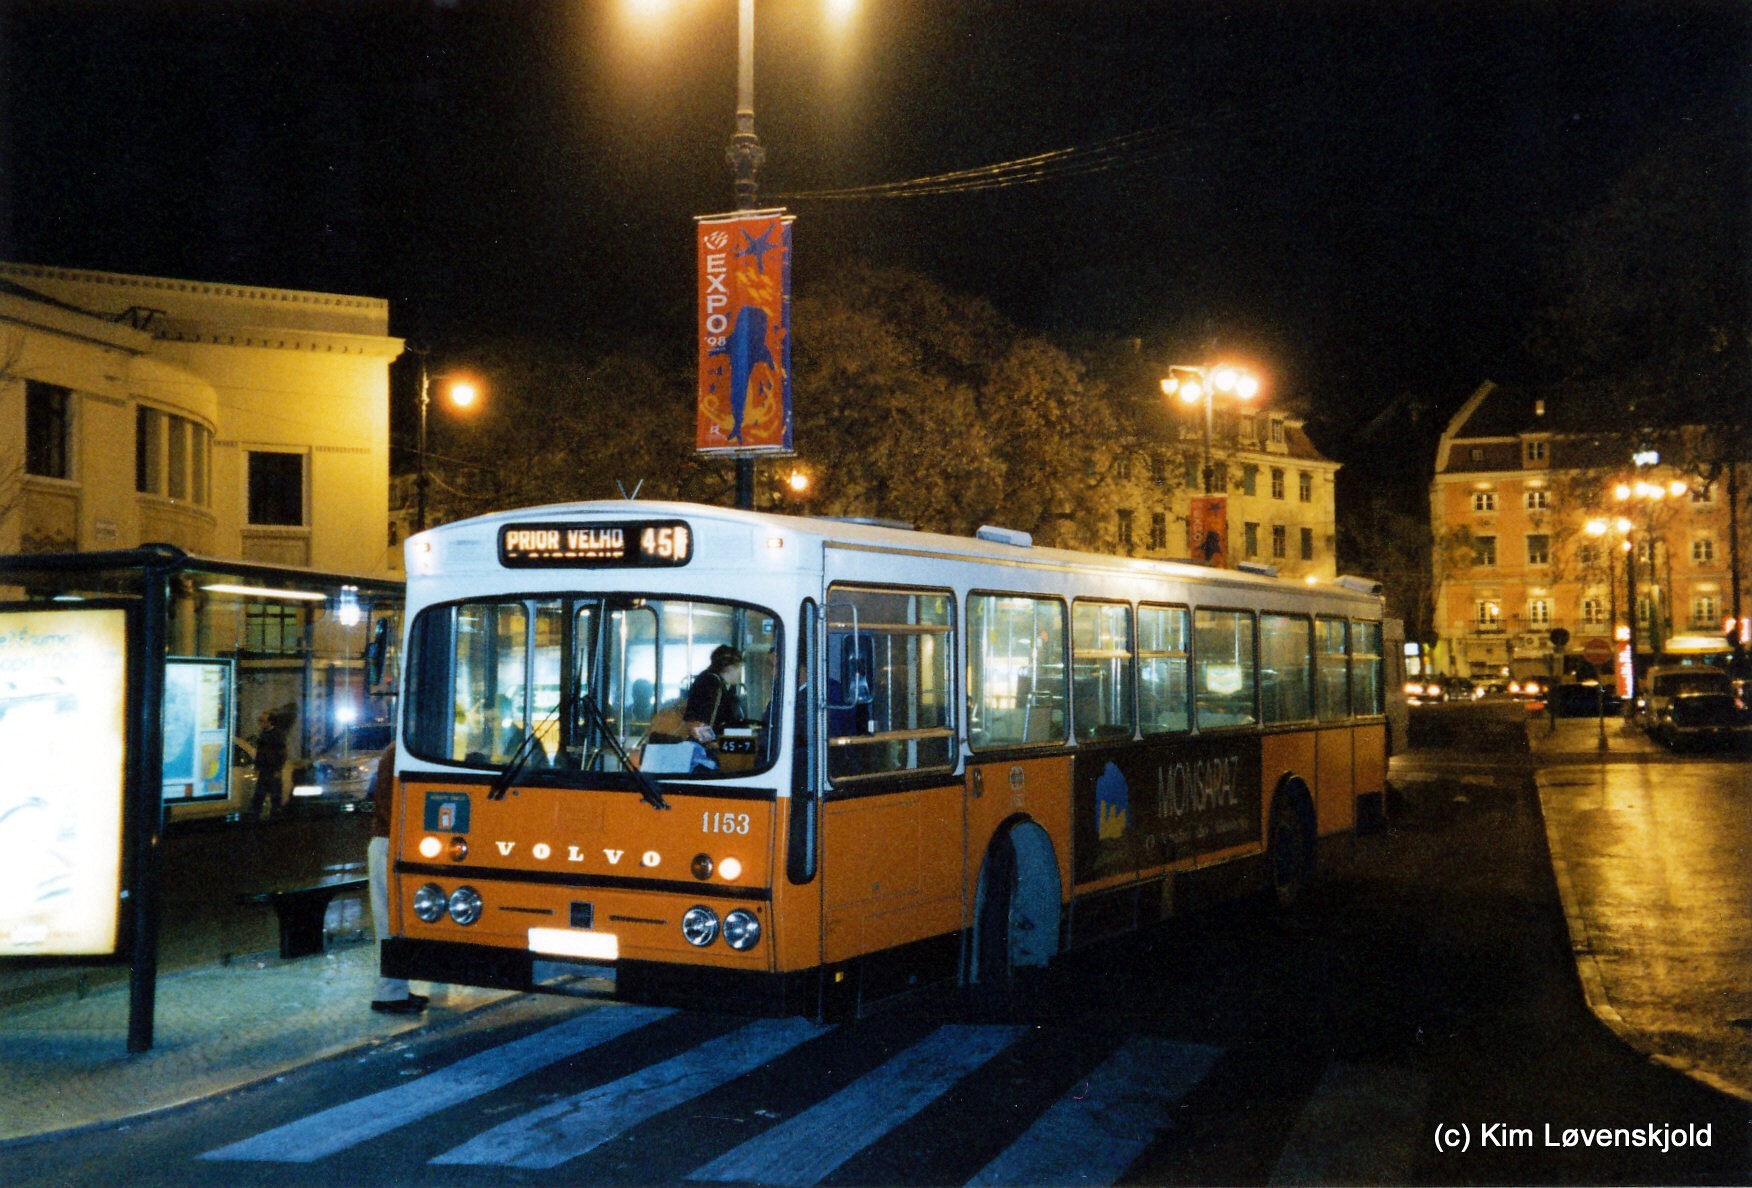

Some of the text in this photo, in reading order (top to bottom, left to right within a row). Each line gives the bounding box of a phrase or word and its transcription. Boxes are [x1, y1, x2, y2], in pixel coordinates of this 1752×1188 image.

[706, 253, 728, 333] EXPO
[704, 336, 726, 347] '98
[506, 529, 624, 550] PRIOR VELHO
[701, 811, 750, 835] 1153
[496, 841, 661, 868] VOLVO
